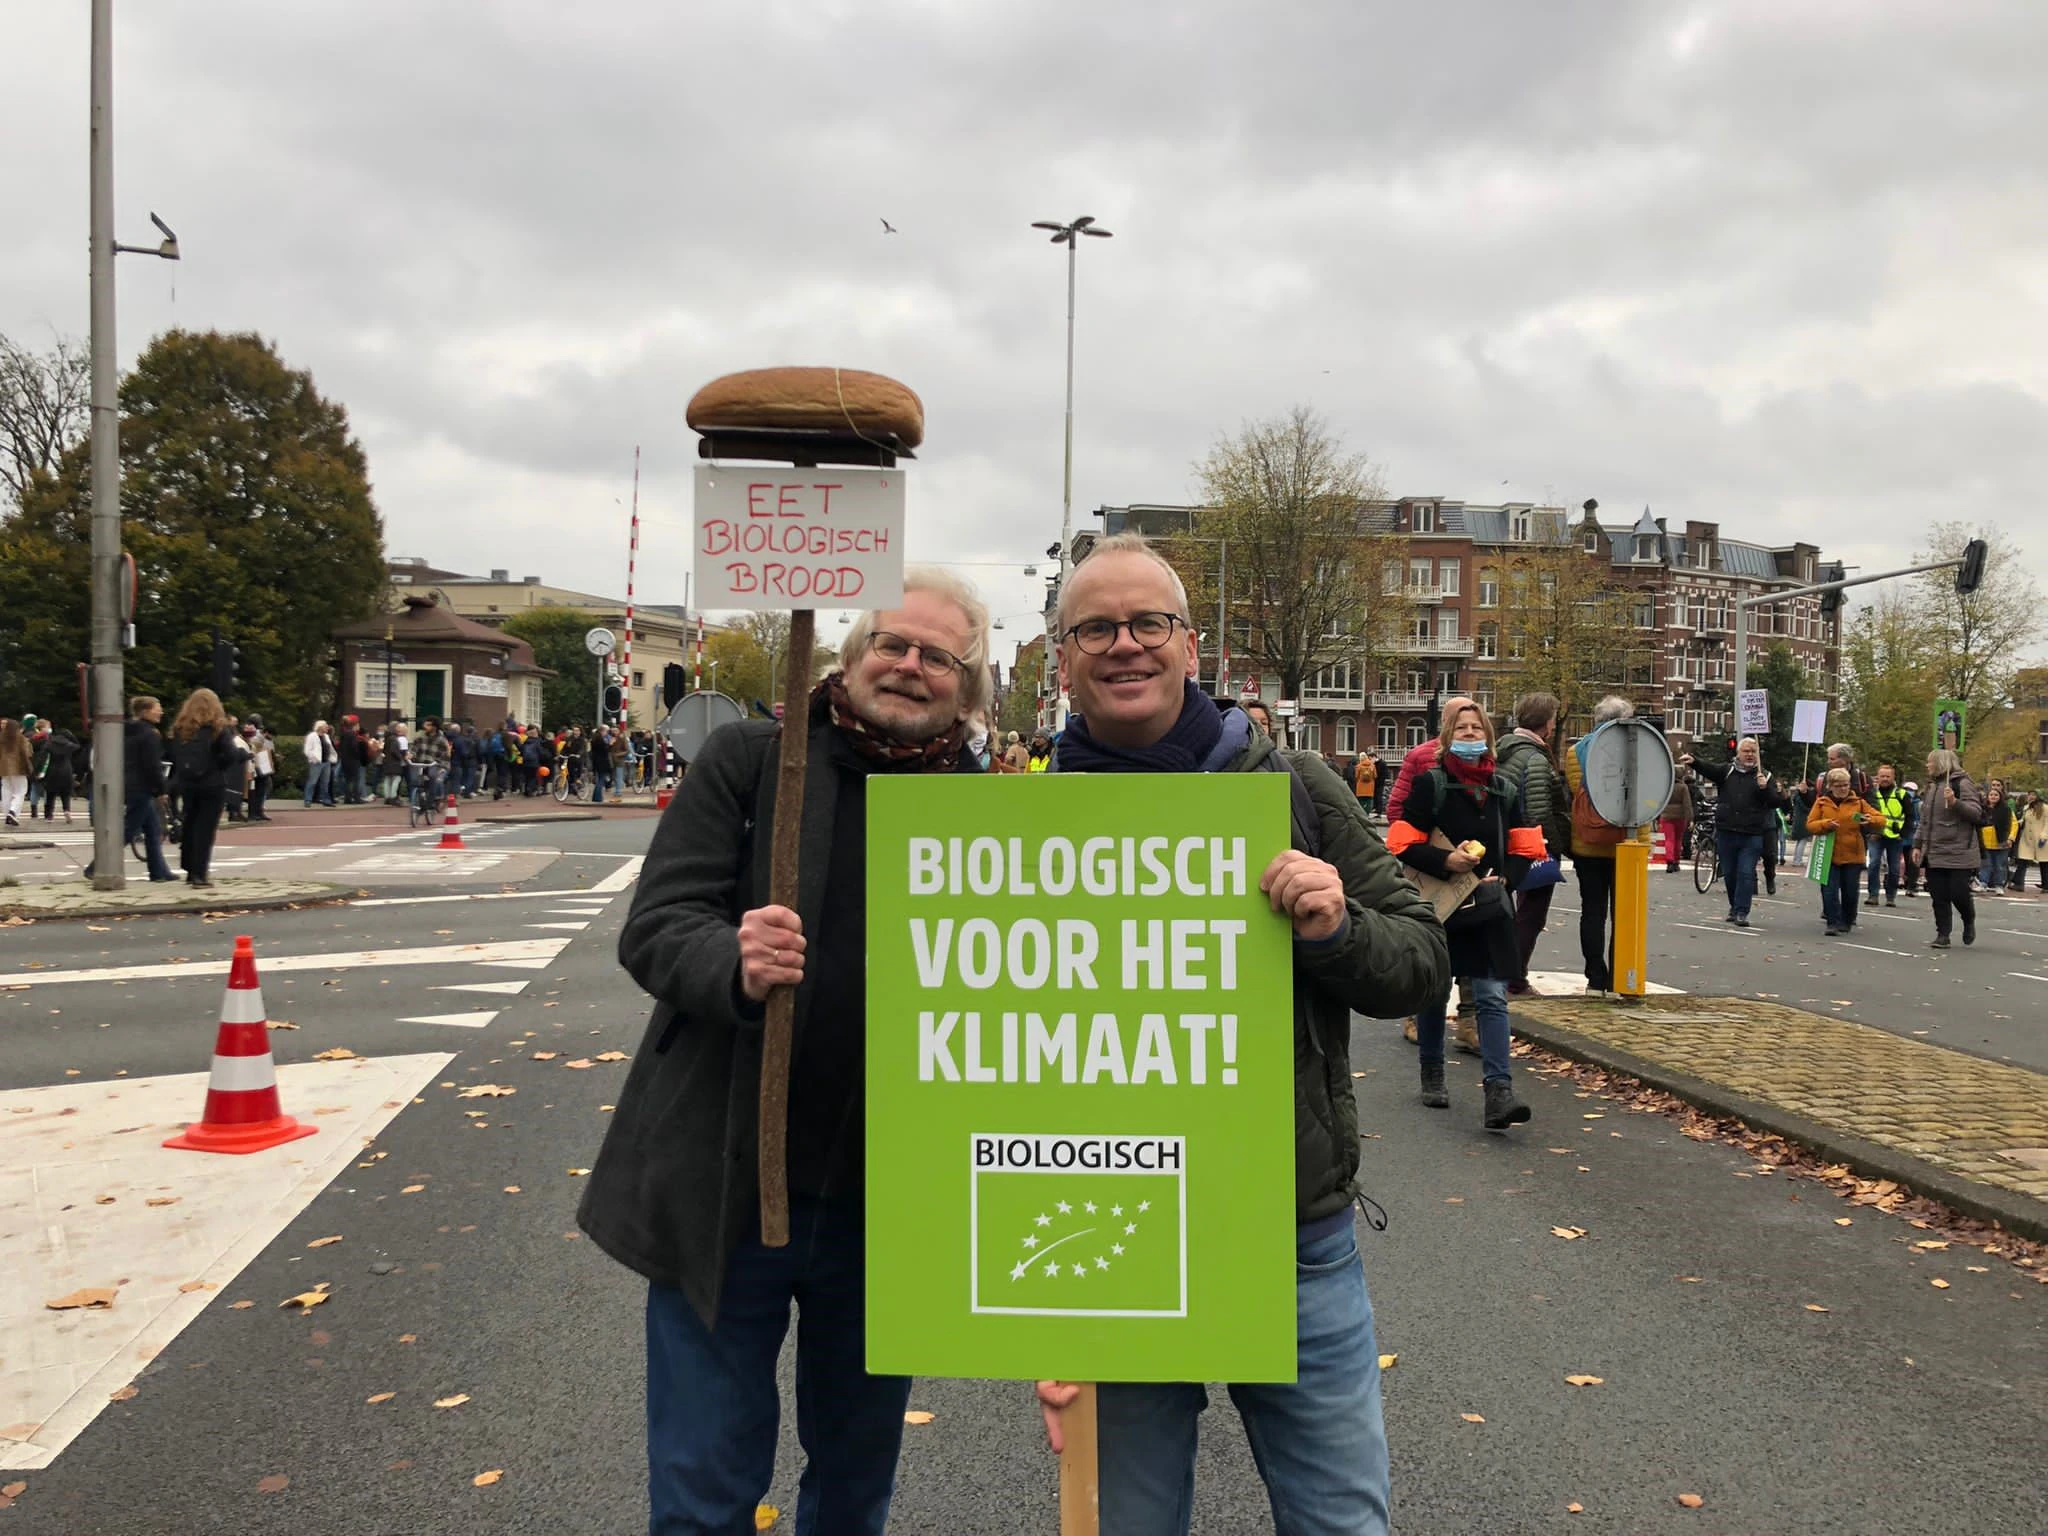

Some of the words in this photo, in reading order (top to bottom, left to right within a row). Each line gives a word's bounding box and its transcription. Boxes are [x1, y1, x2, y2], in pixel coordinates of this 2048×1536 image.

[748, 482, 843, 518] EET
[702, 519, 889, 556] BIOLOGISCH
[725, 562, 865, 598] BROOD
[908, 835, 1247, 897] BIOLOGISCH
[910, 917, 1100, 990] VOOR
[1121, 918, 1247, 991] HET
[917, 1011, 1239, 1085] KLIMAAT!
[975, 1138, 1181, 1170] BIOLOGISCH
